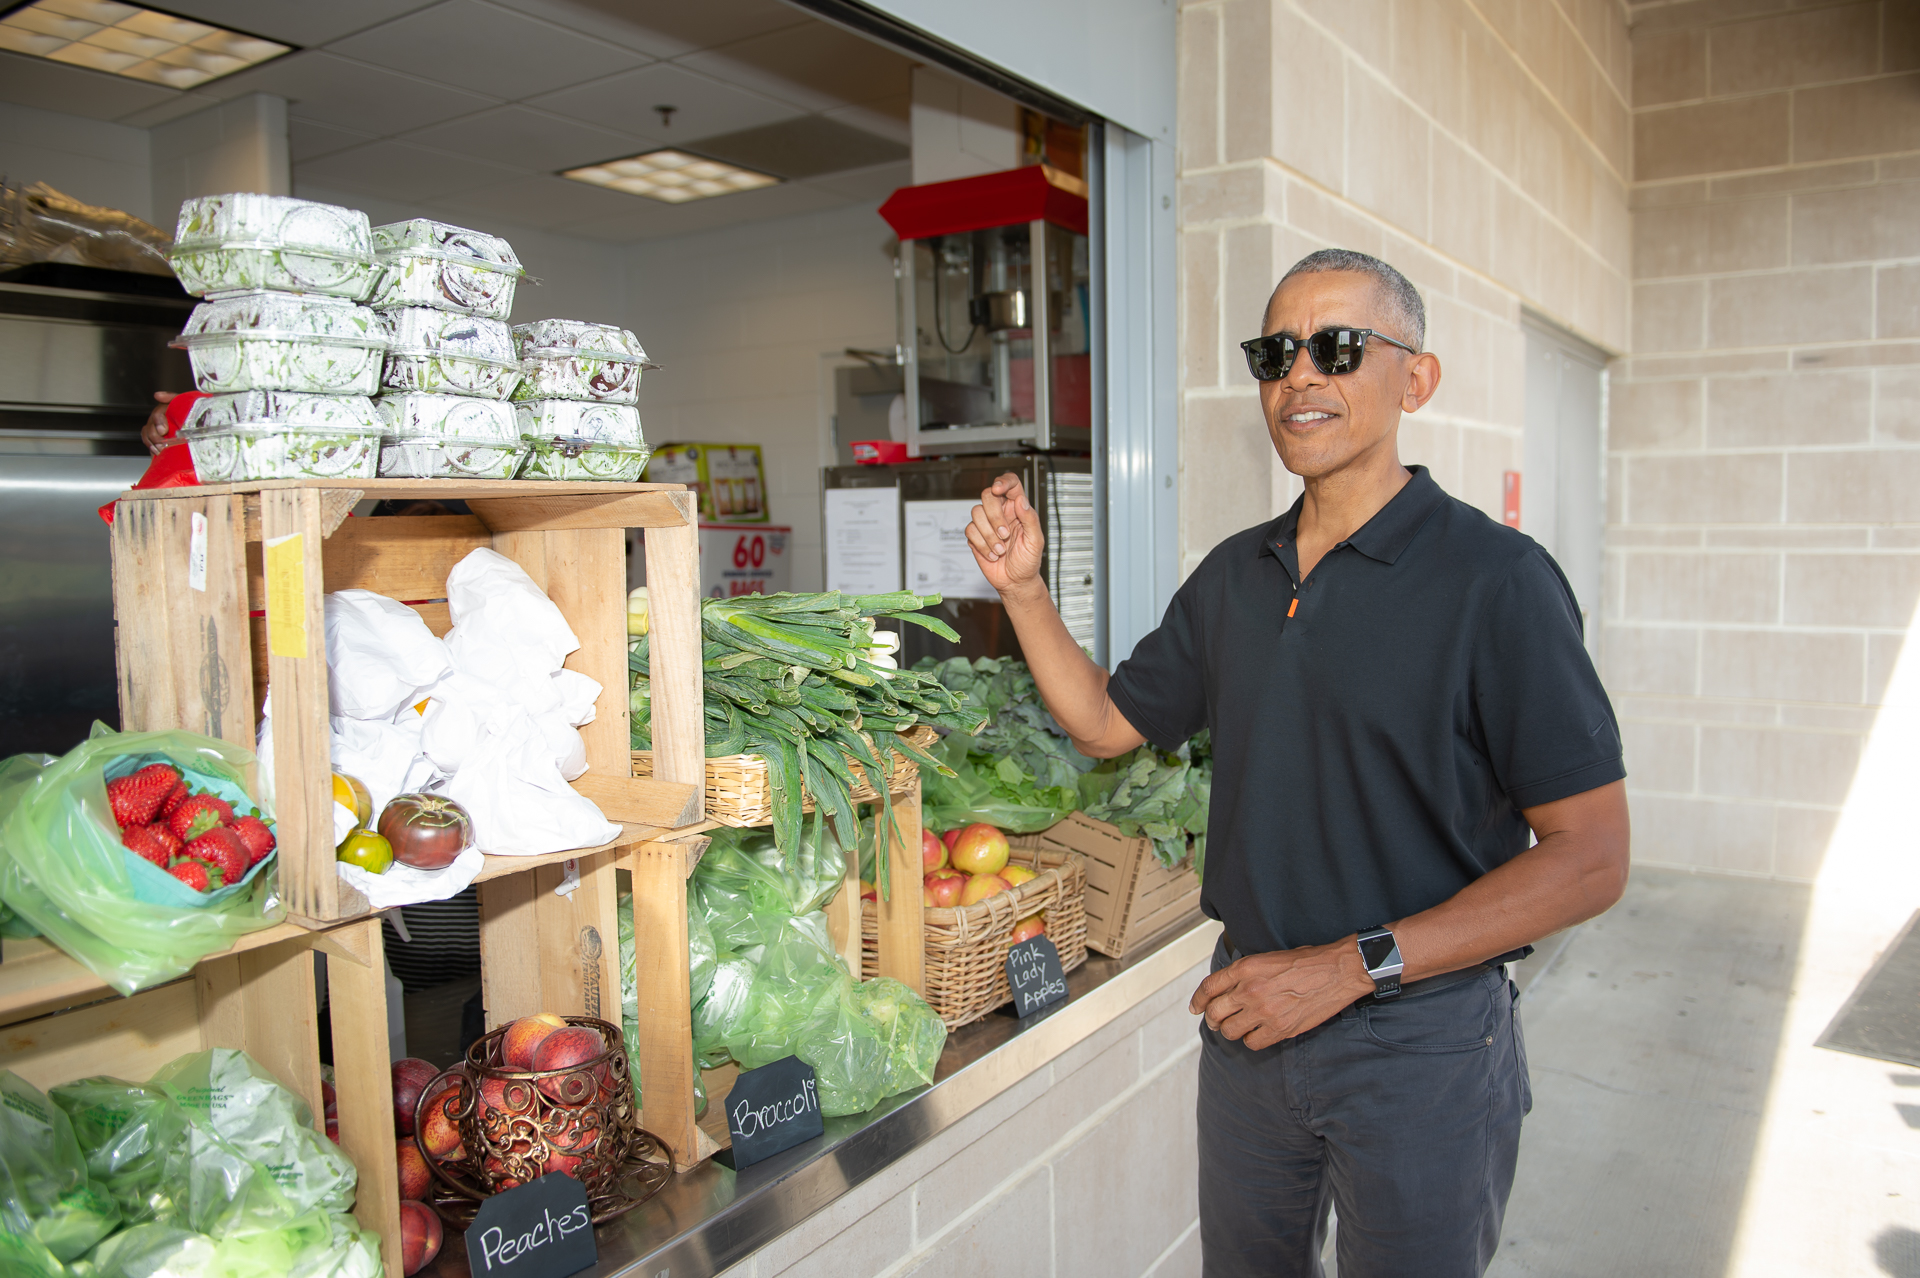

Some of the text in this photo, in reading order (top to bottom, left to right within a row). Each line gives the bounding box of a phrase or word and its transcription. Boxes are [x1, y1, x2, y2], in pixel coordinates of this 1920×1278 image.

[733, 535, 765, 568] 60
[1009, 943, 1045, 968] Pink
[1014, 962, 1046, 988] Lady
[1024, 978, 1065, 1010] Apples
[732, 1078, 817, 1138] Broccoli
[480, 1204, 588, 1271] Peaches
